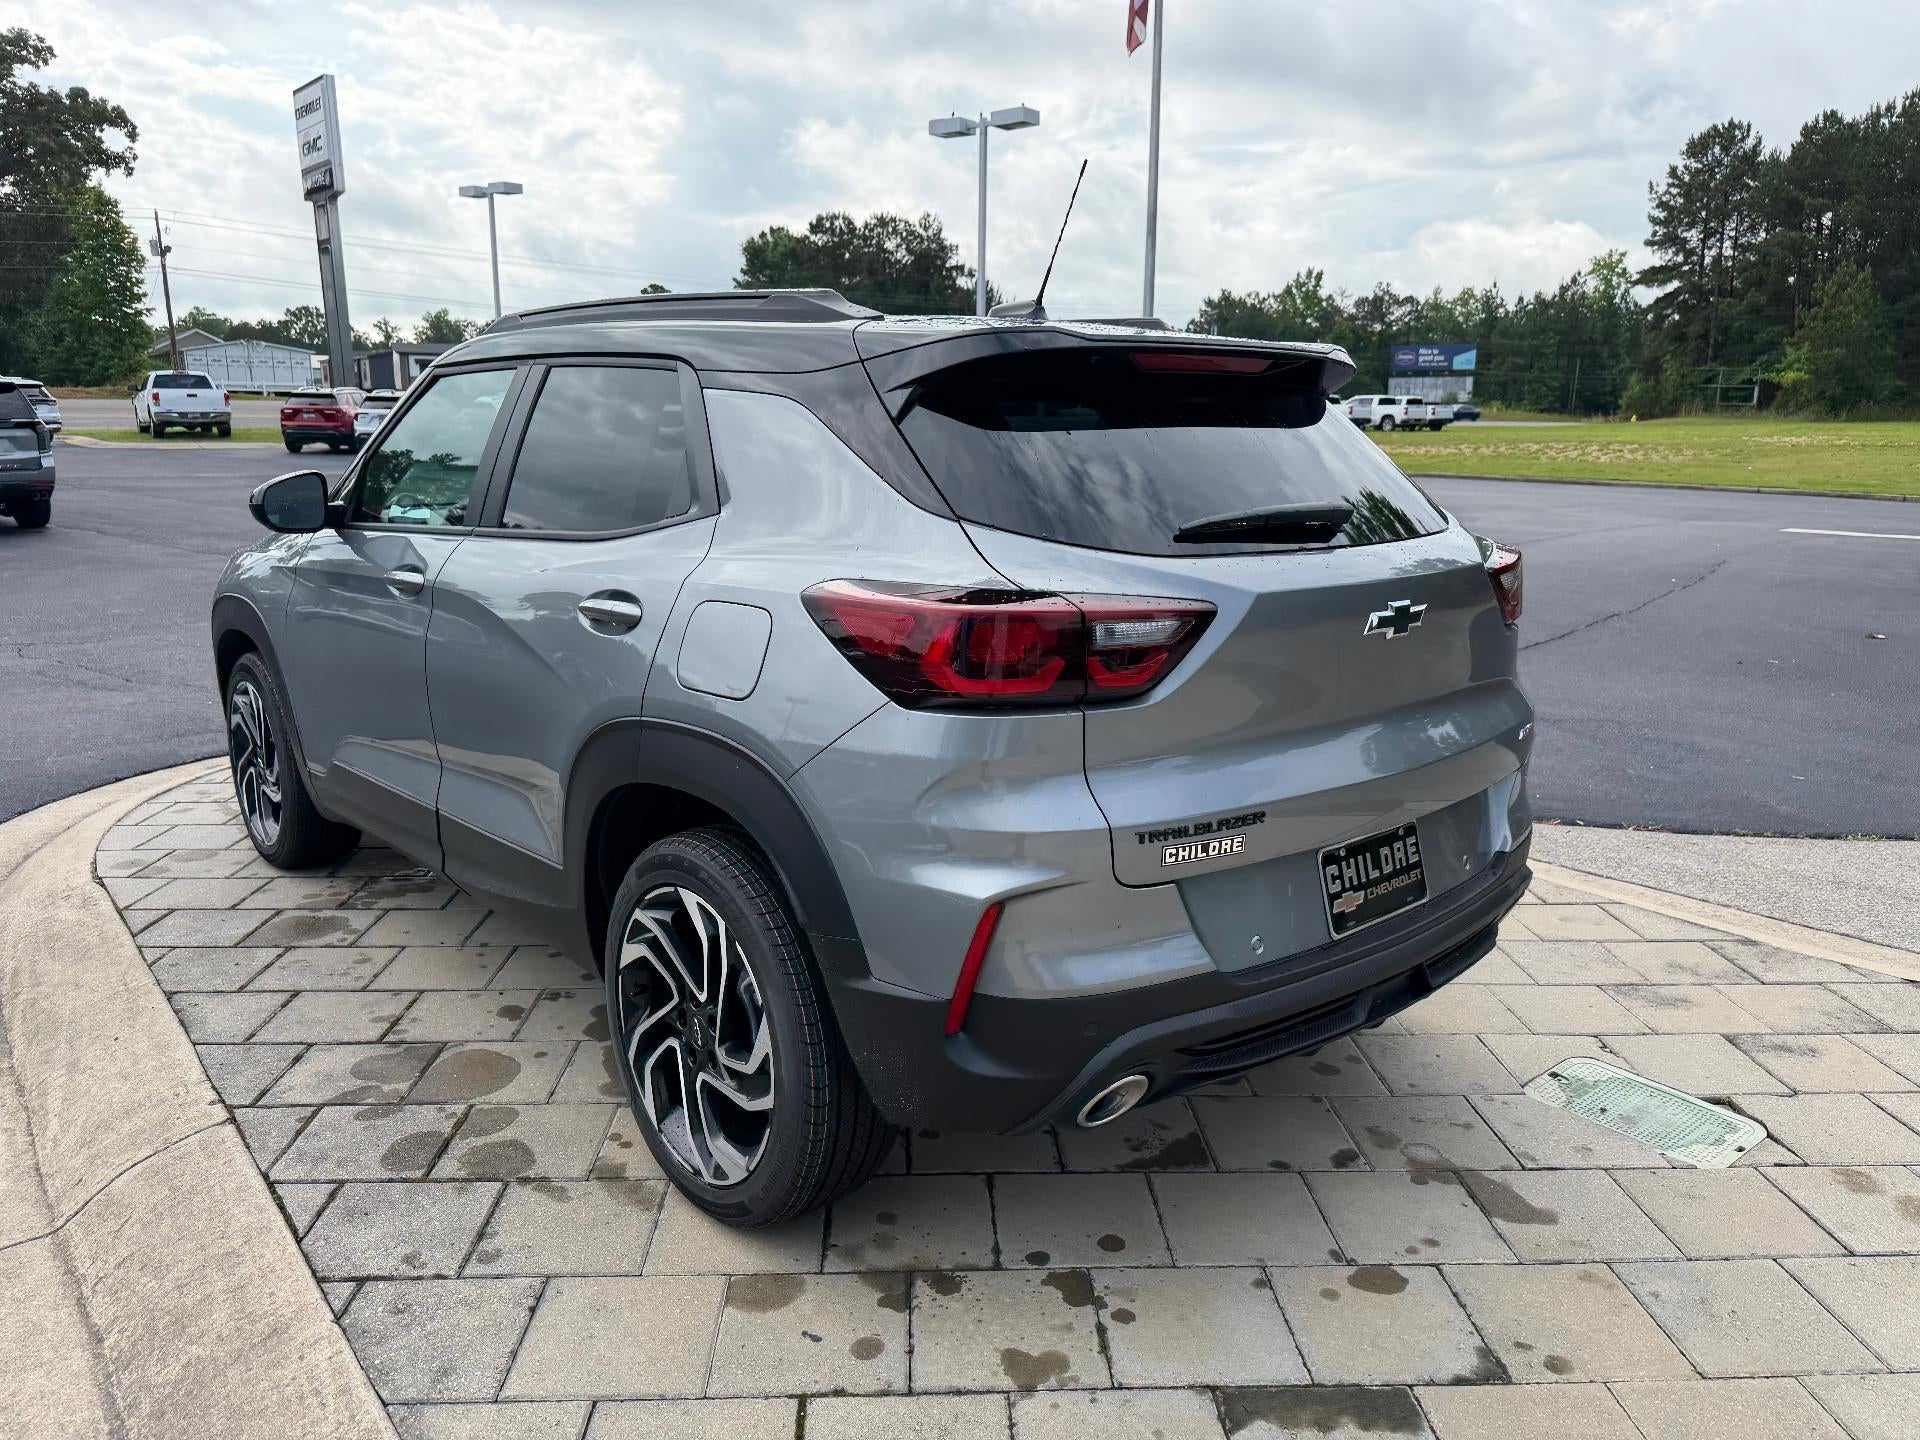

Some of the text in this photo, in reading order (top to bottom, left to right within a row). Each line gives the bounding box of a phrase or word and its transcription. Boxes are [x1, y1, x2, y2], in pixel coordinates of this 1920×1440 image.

[302, 134, 323, 157] GMC
[1135, 811, 1266, 844] TRAILBLAZER
[1165, 838, 1244, 863] CHILDRE
[1325, 836, 1420, 894] CHILDRE
[1367, 869, 1422, 899] CHEVROLET
